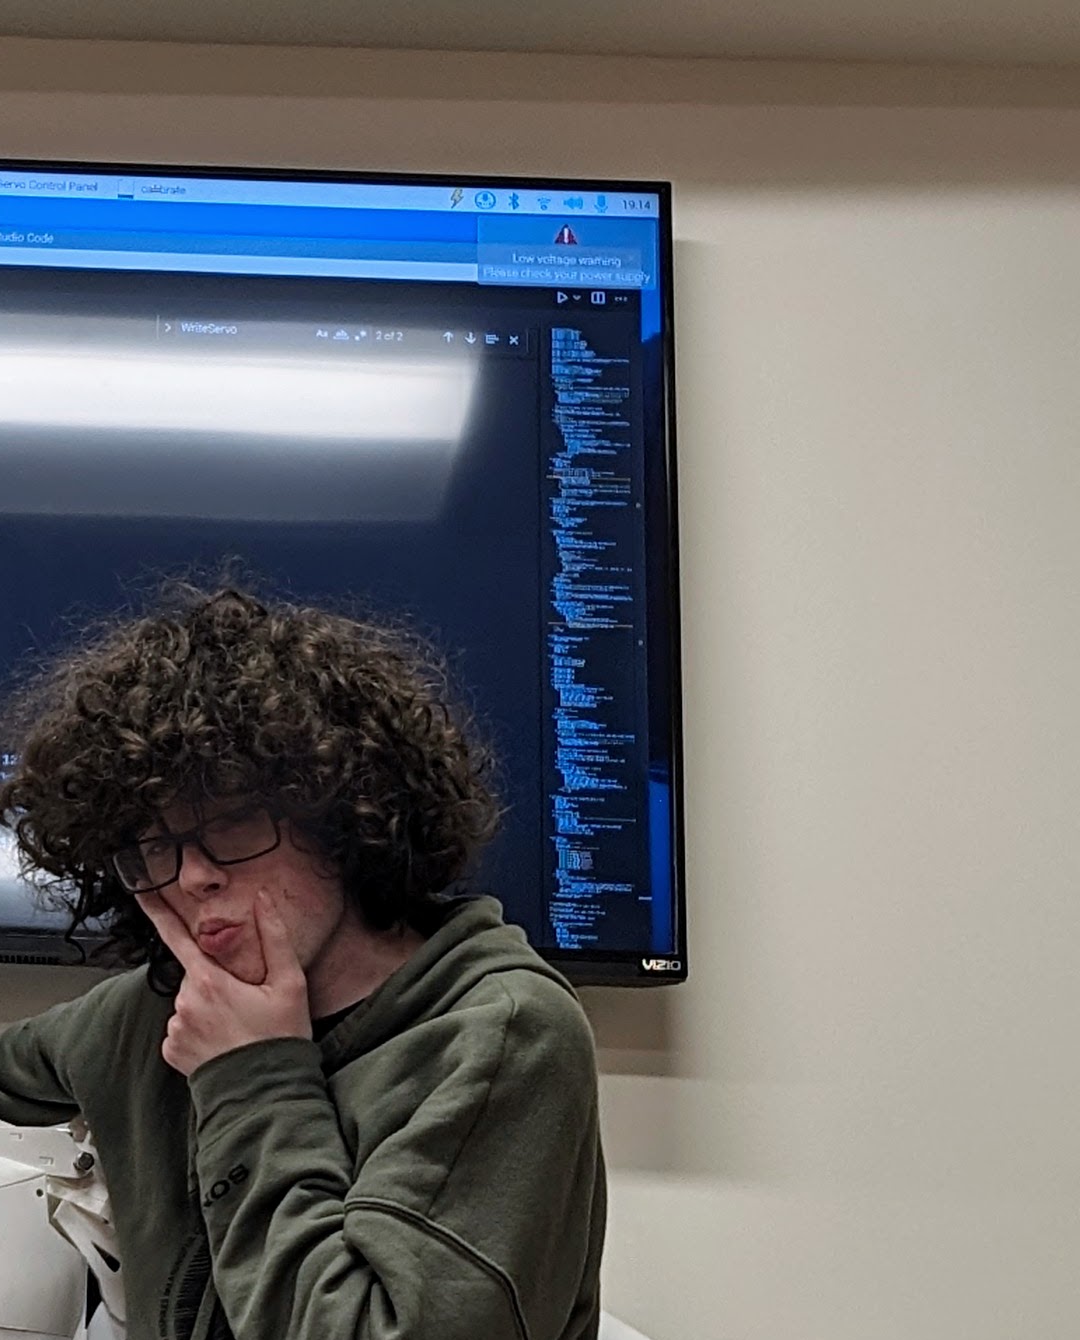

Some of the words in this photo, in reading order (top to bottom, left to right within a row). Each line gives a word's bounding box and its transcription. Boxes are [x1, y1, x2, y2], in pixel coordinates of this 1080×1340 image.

[29, 180, 66, 190] Control
[70, 181, 98, 192] Panel
[27, 233, 54, 243] Code
[513, 253, 534, 265] Low
[537, 254, 575, 267] voltage
[578, 256, 621, 267] warning
[521, 268, 551, 278] check
[554, 271, 578, 281] your
[580, 271, 612, 281] power
[181, 321, 238, 335] WriteServo
[642, 958, 681, 970] VIZIO
